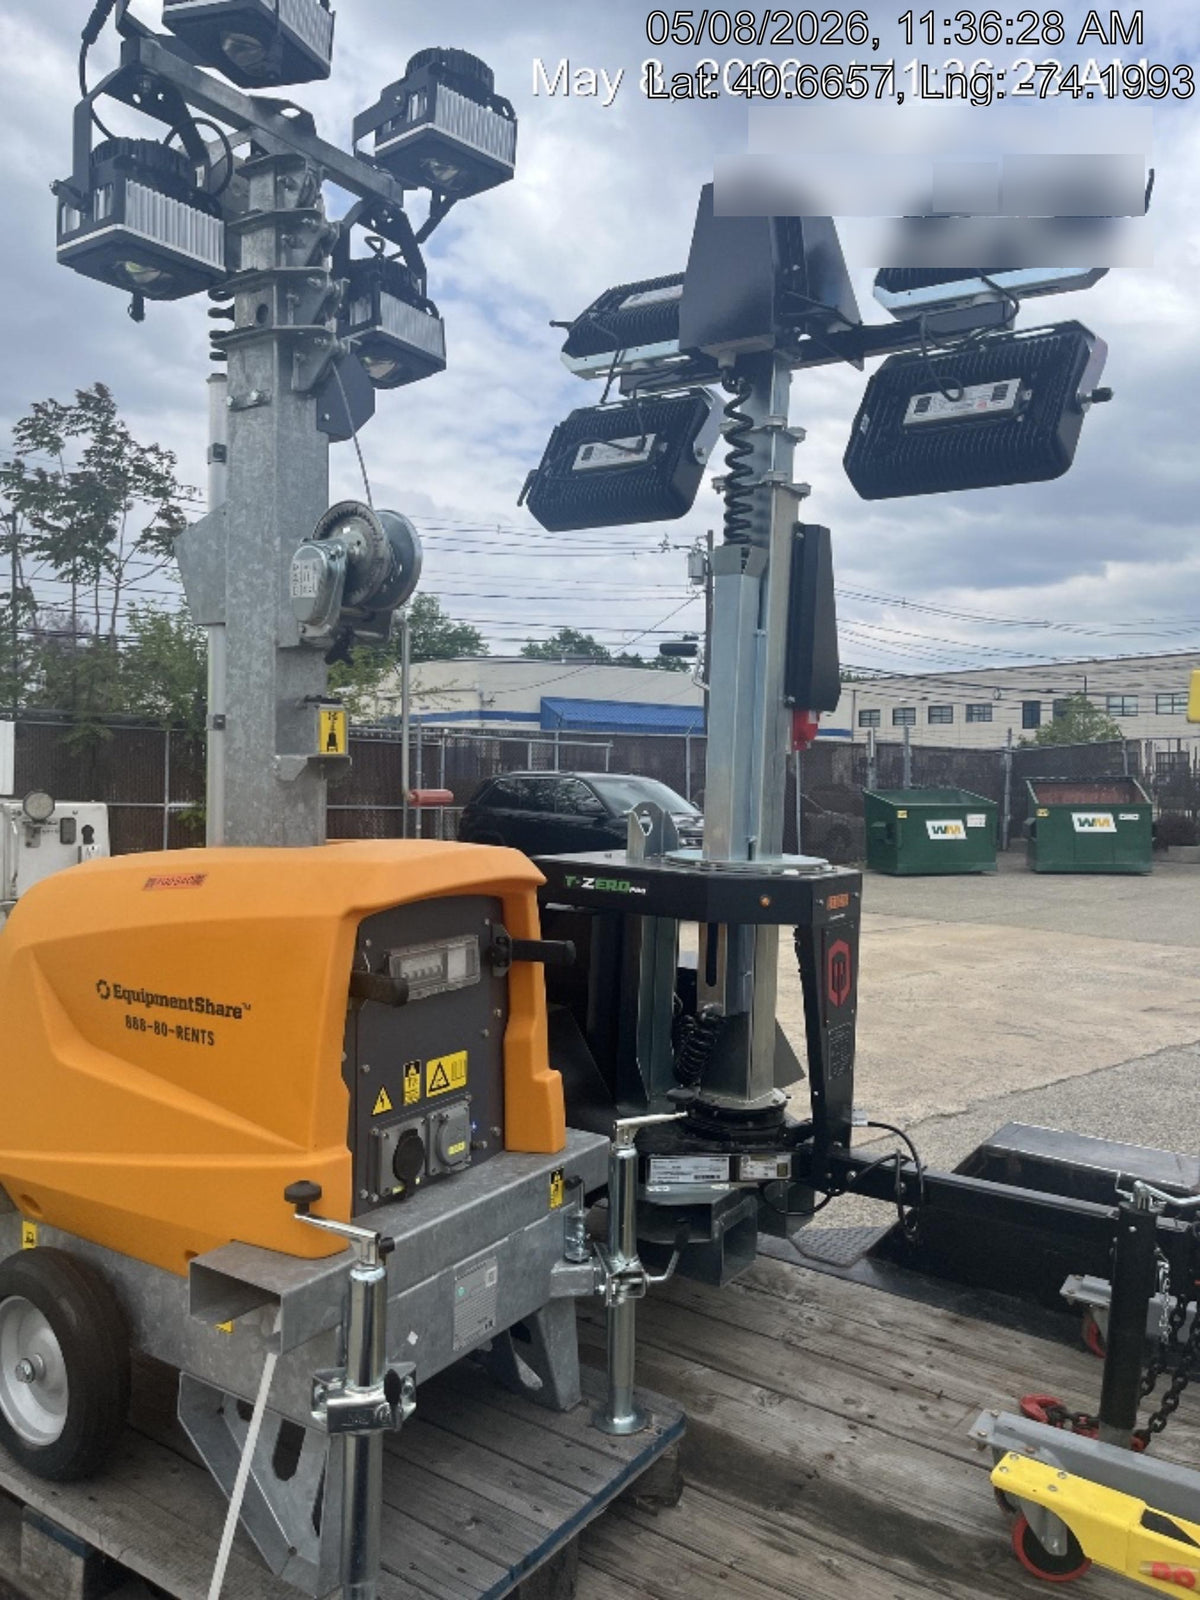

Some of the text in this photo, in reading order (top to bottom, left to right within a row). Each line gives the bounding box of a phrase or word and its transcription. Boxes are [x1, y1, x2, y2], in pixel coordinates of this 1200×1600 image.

[932, 825, 961, 835] WM
[1077, 817, 1110, 828] WM
[112, 983, 243, 1019] EquipmentShare
[125, 1014, 215, 1046] 888-80-RENTS
